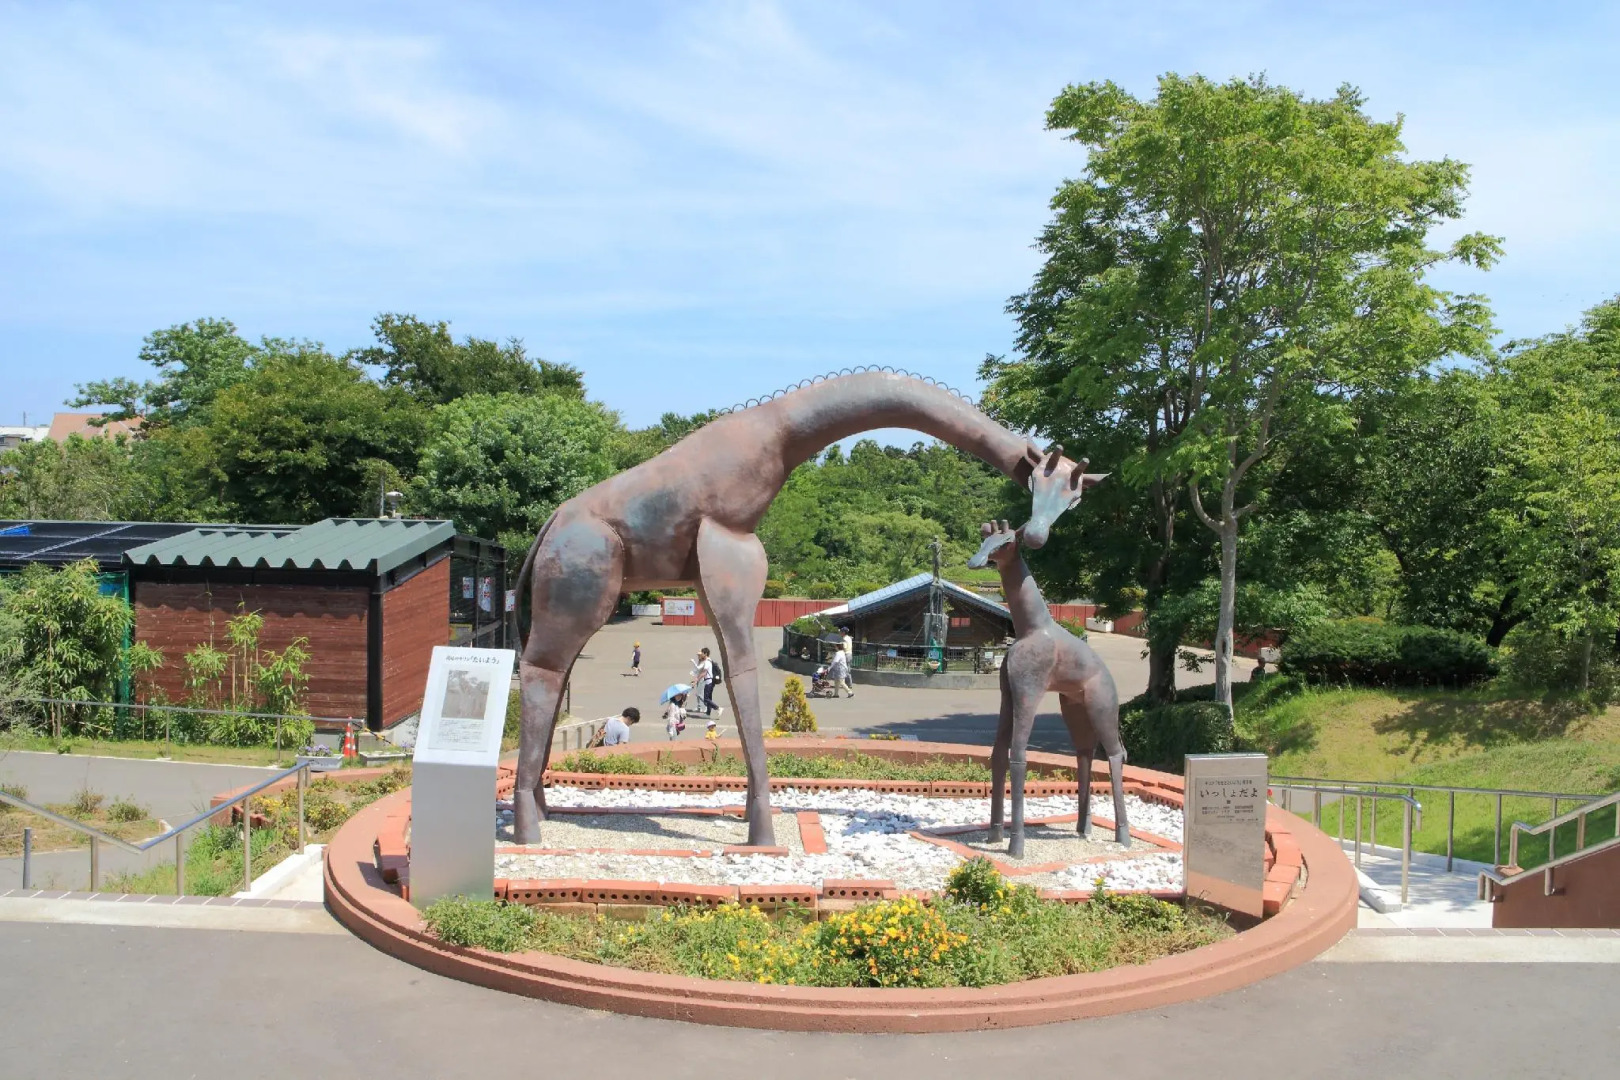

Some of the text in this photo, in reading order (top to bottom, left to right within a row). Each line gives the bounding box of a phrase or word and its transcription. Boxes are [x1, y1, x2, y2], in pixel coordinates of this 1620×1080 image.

[1200, 788, 1258, 798] いっしょだよ
